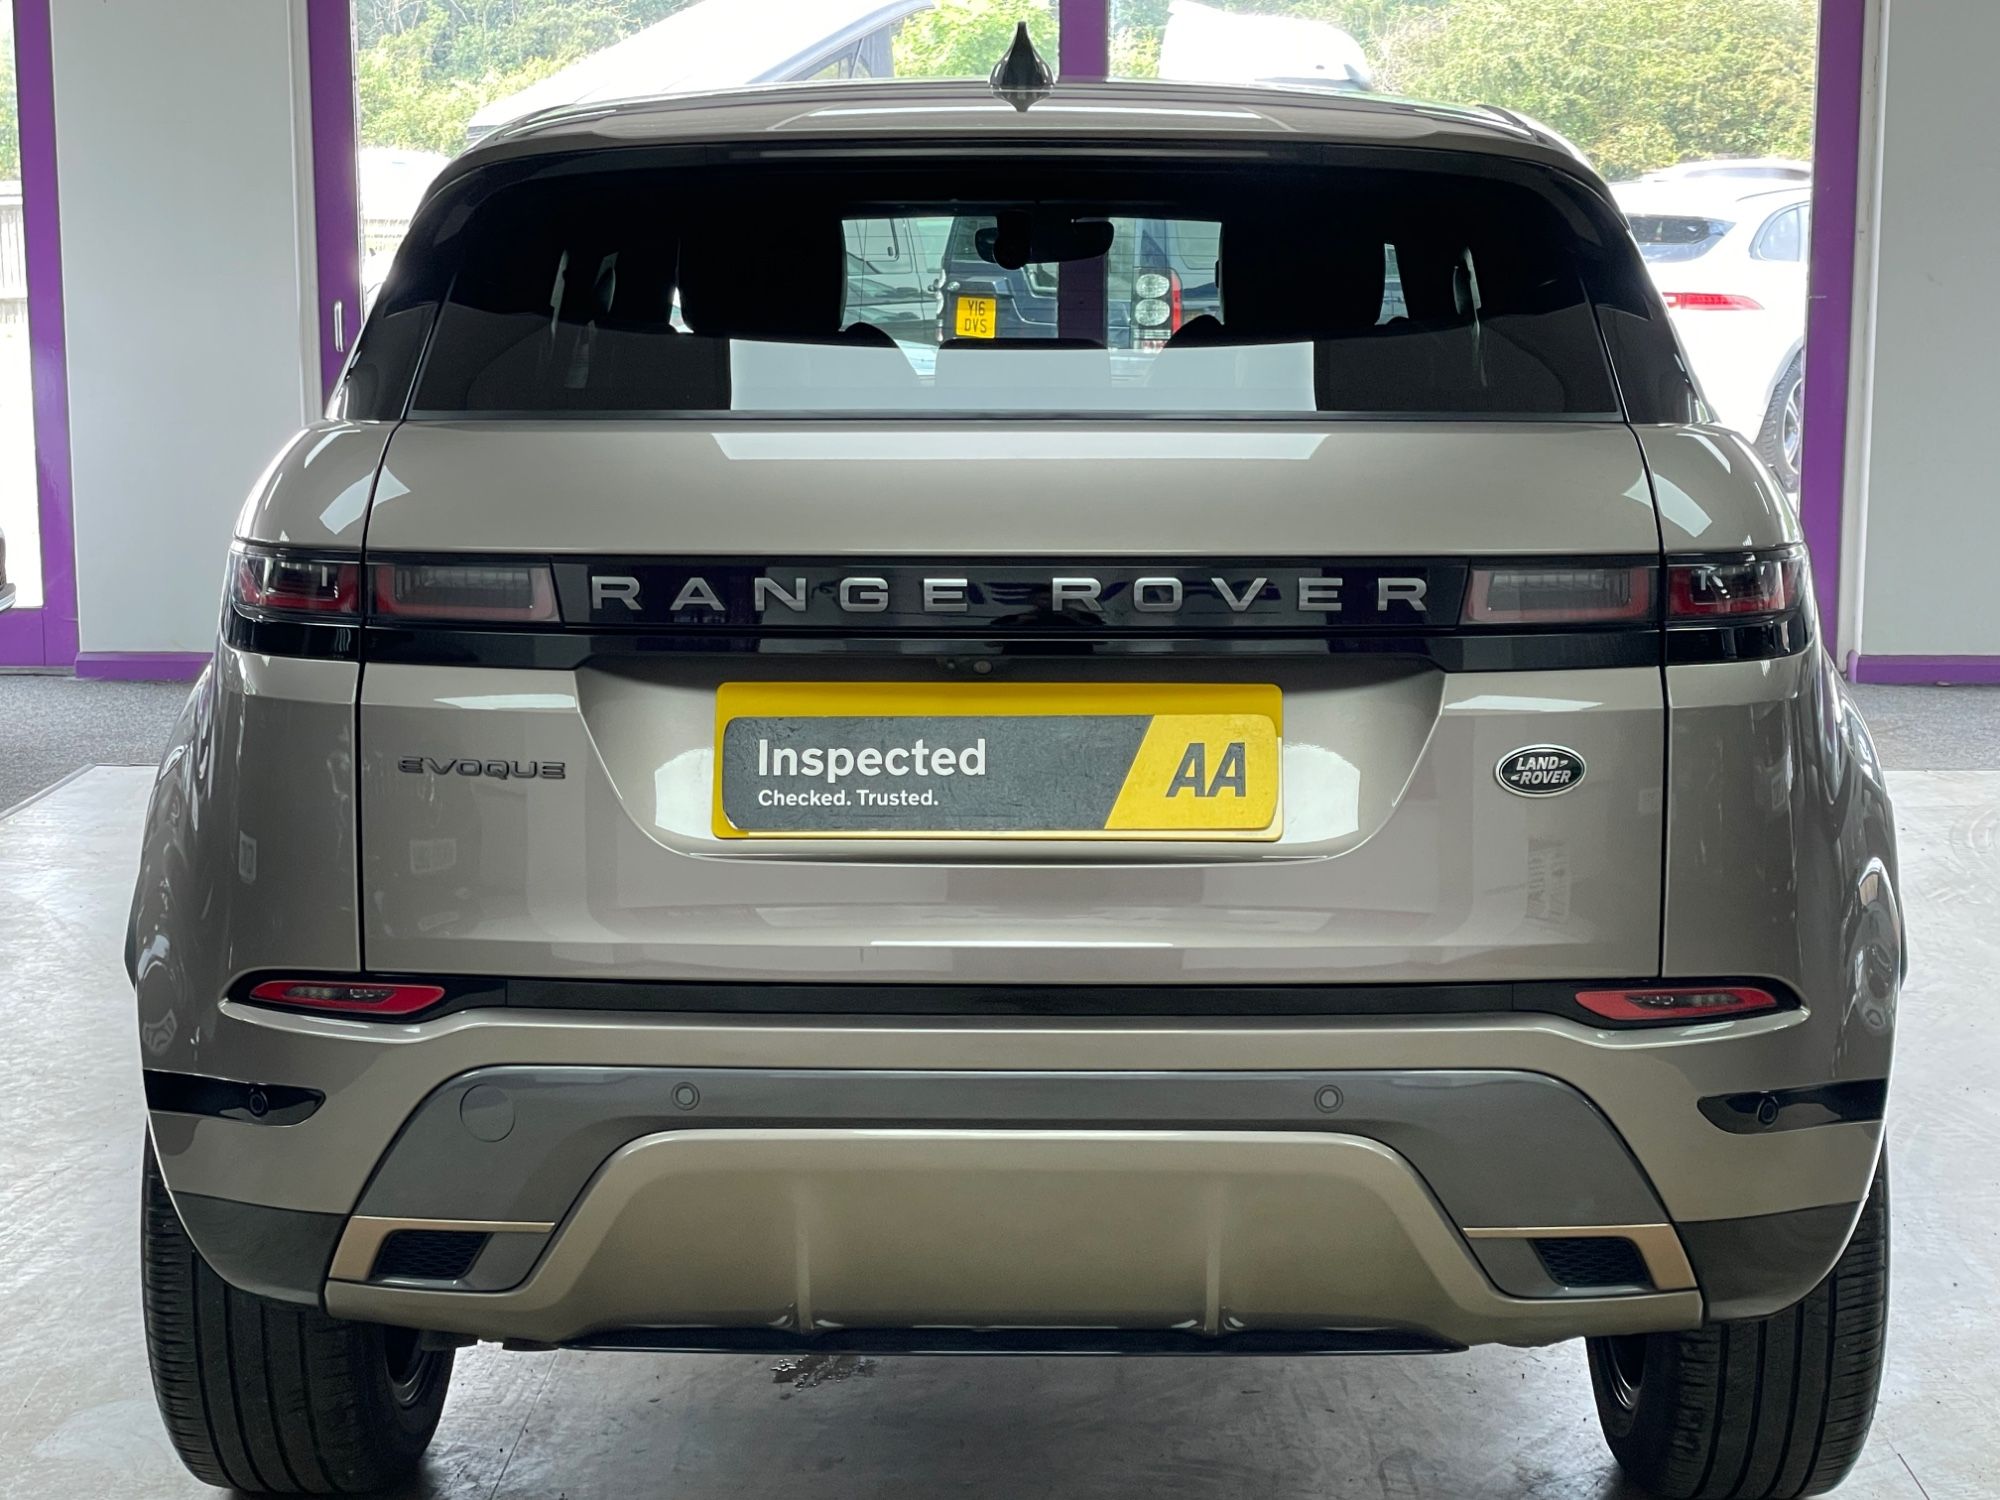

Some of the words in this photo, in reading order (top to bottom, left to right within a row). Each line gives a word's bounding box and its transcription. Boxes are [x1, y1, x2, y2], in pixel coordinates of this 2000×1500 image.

[967, 300, 985, 316] Y16
[964, 318, 987, 333] DVS
[591, 575, 968, 613] RANGE
[1051, 577, 1428, 613] ROVER
[398, 756, 566, 780] EVOQUE
[757, 738, 986, 784] Inspected
[1516, 756, 1559, 771] LAND
[1165, 742, 1248, 798] AA
[1519, 769, 1572, 785] ROVER
[757, 789, 852, 806] Checked.
[855, 789, 939, 806] Trusted.
